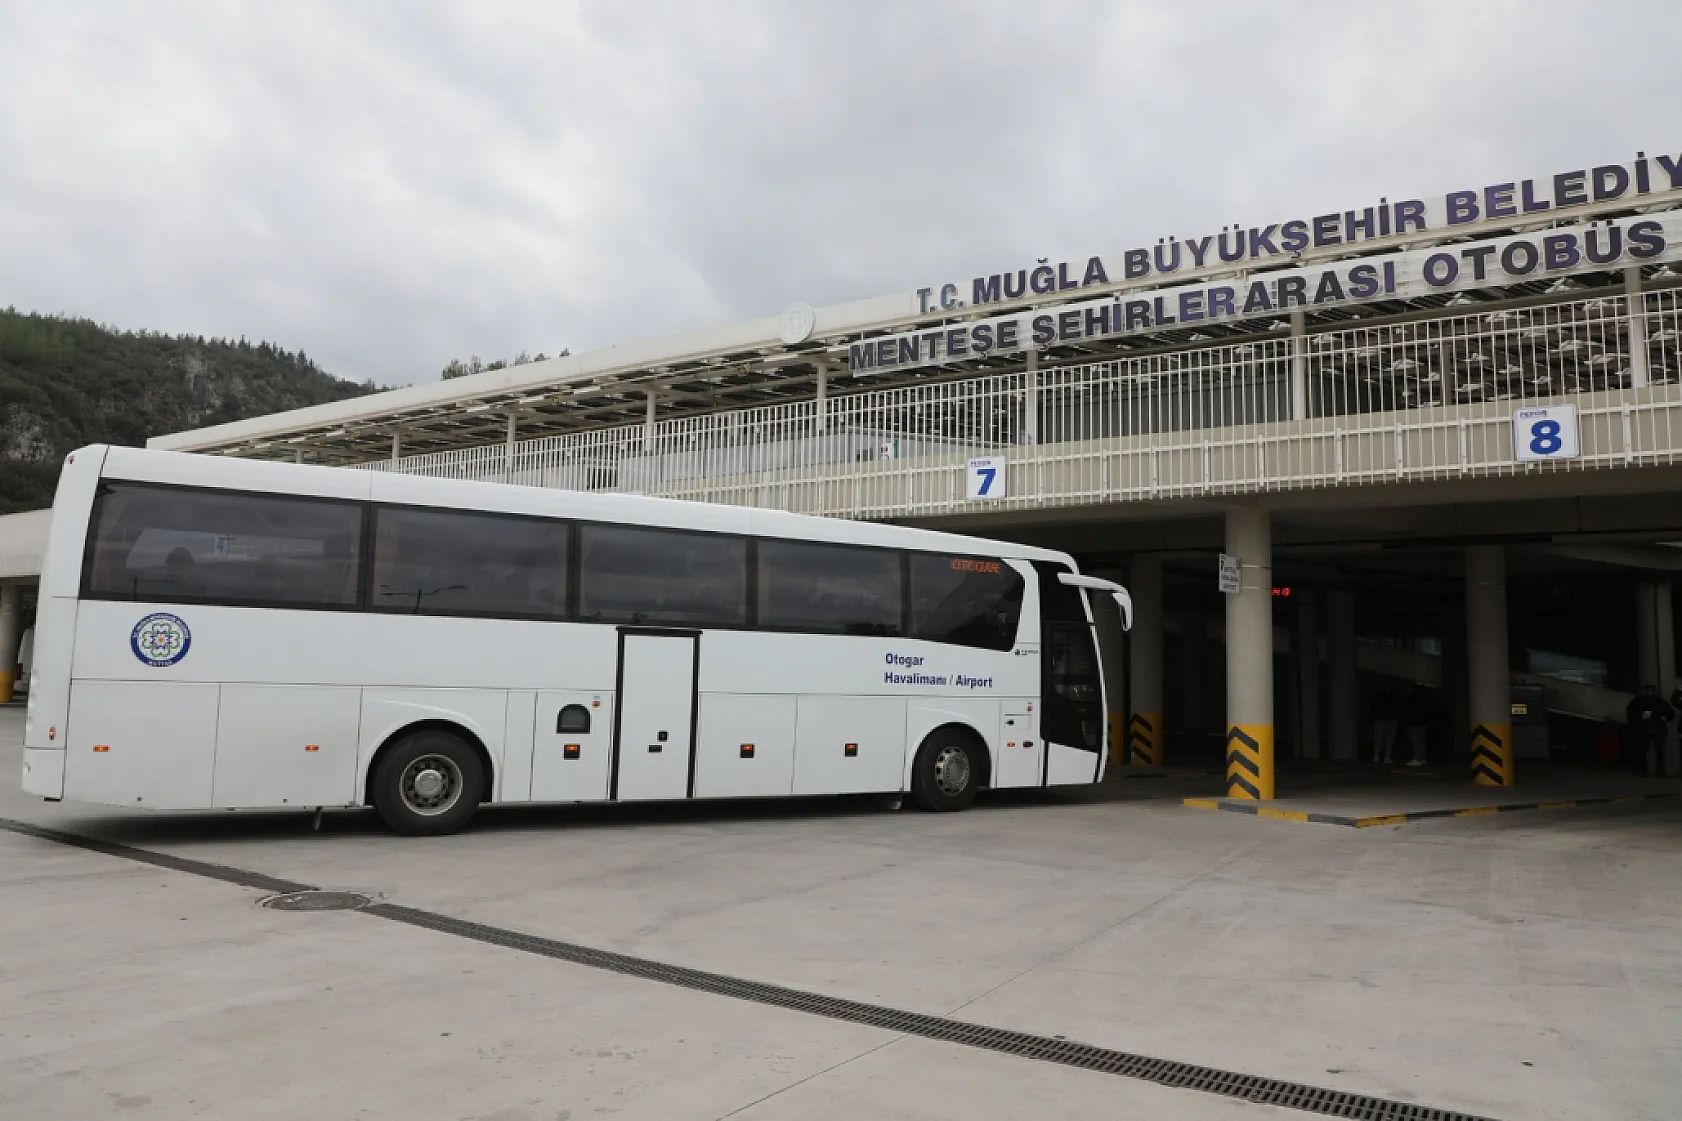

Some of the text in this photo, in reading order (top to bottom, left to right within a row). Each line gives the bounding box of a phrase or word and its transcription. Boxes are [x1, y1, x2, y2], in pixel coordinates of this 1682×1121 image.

[916, 282, 965, 315] T.C.
[972, 256, 1109, 305] MUĞLA
[1124, 196, 1428, 279] BÜYÜKŞEHİR
[849, 220, 1667, 371] MENTEŞE ŞEHİRLERARASI OTOBÜS
[1530, 420, 1561, 454] 8
[977, 468, 996, 495] 7
[885, 652, 924, 668] Otogar
[884, 672, 947, 686] Havalimanı
[955, 674, 993, 689] Airport
